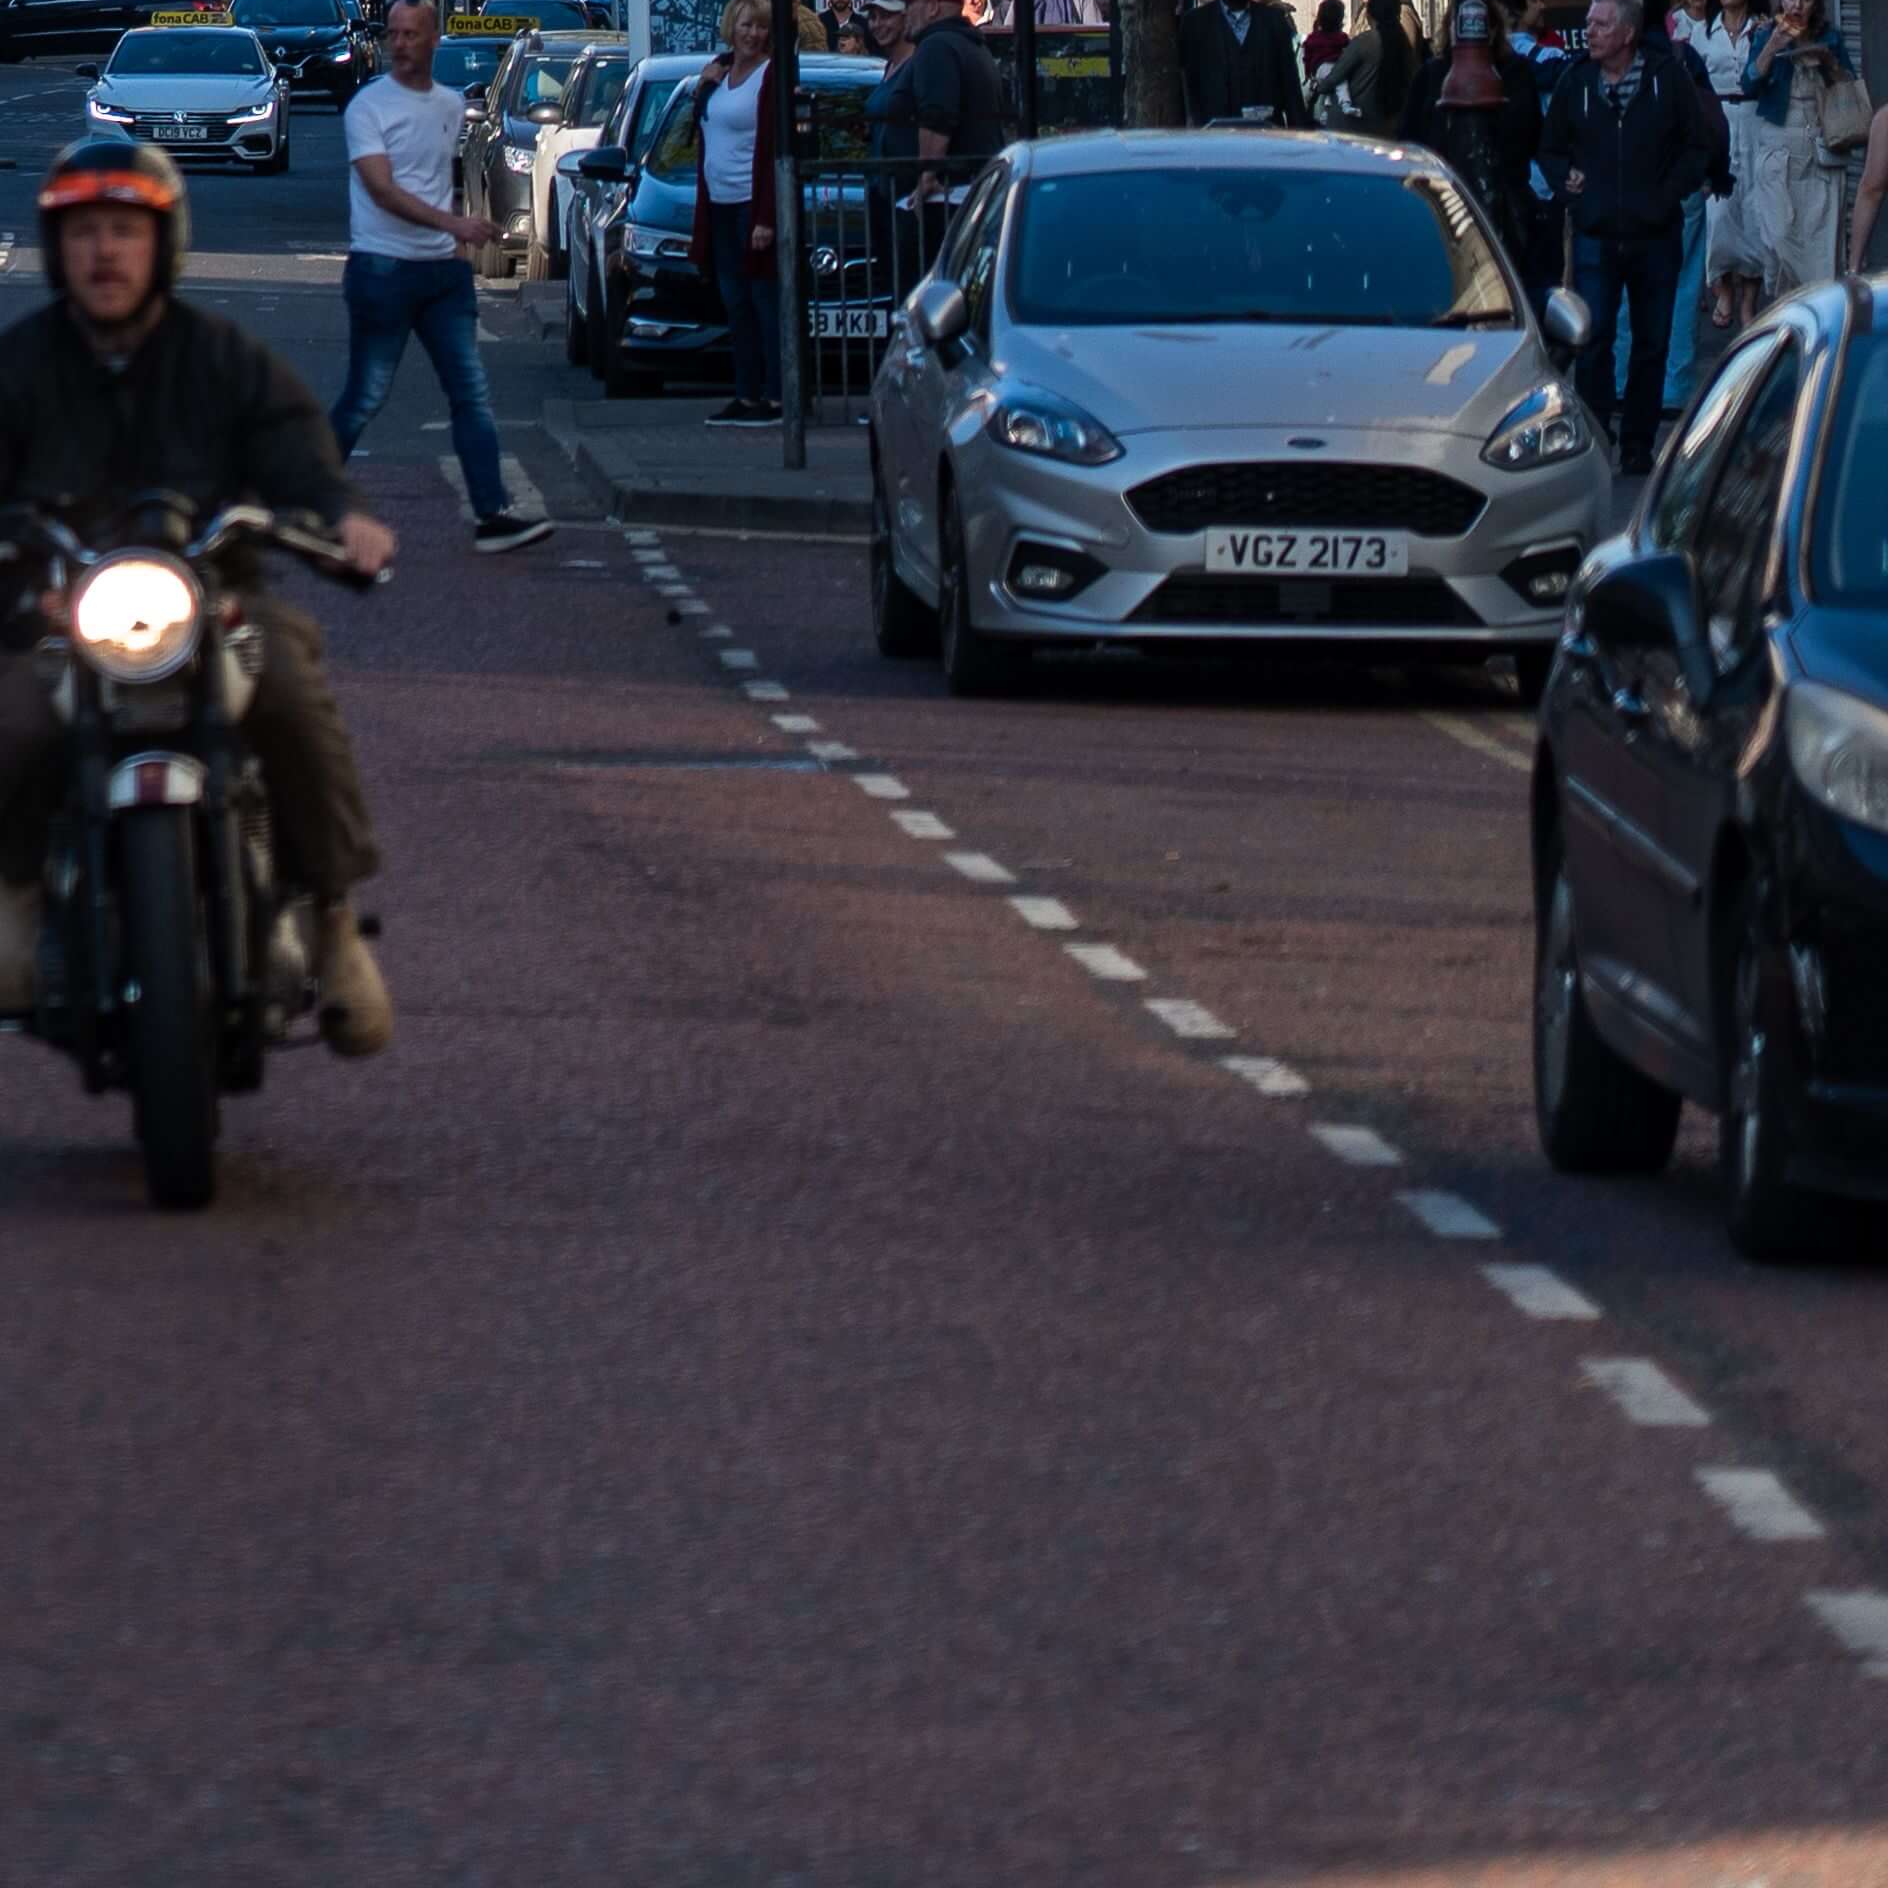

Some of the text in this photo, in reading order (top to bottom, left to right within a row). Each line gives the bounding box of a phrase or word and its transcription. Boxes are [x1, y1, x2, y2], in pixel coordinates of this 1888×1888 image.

[153, 12, 210, 24] fonaCAB
[450, 17, 513, 31] fonaCAB
[1229, 534, 1387, 569] VGZ 2173
